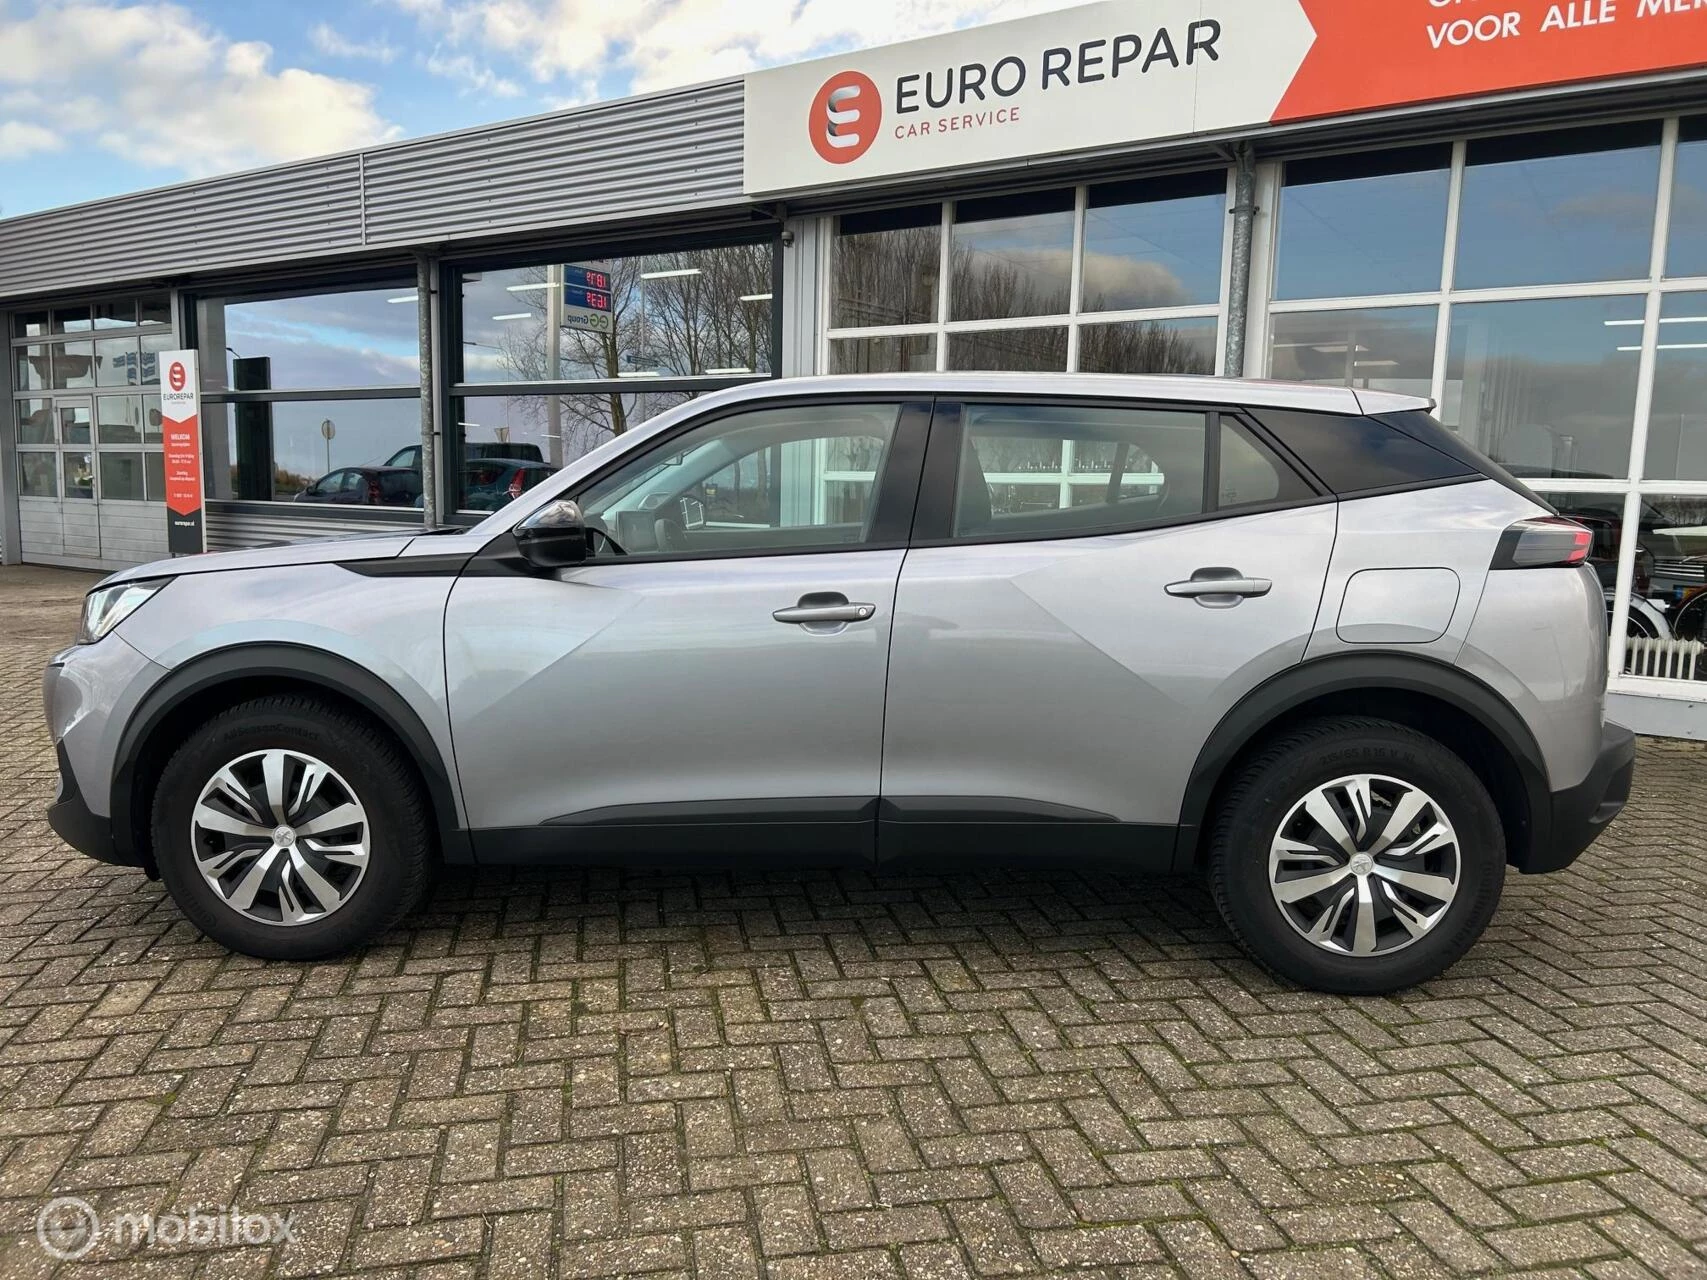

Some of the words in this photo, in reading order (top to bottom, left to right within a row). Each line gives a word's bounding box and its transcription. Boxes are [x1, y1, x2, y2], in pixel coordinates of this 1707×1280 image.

[1426, 12, 1521, 49] VOOR
[1540, 0, 1617, 32] ALLE
[896, 55, 1026, 115] EURO
[1042, 18, 1221, 90] REPAR
[895, 120, 931, 139] CAR
[938, 107, 1020, 133] SERVICE
